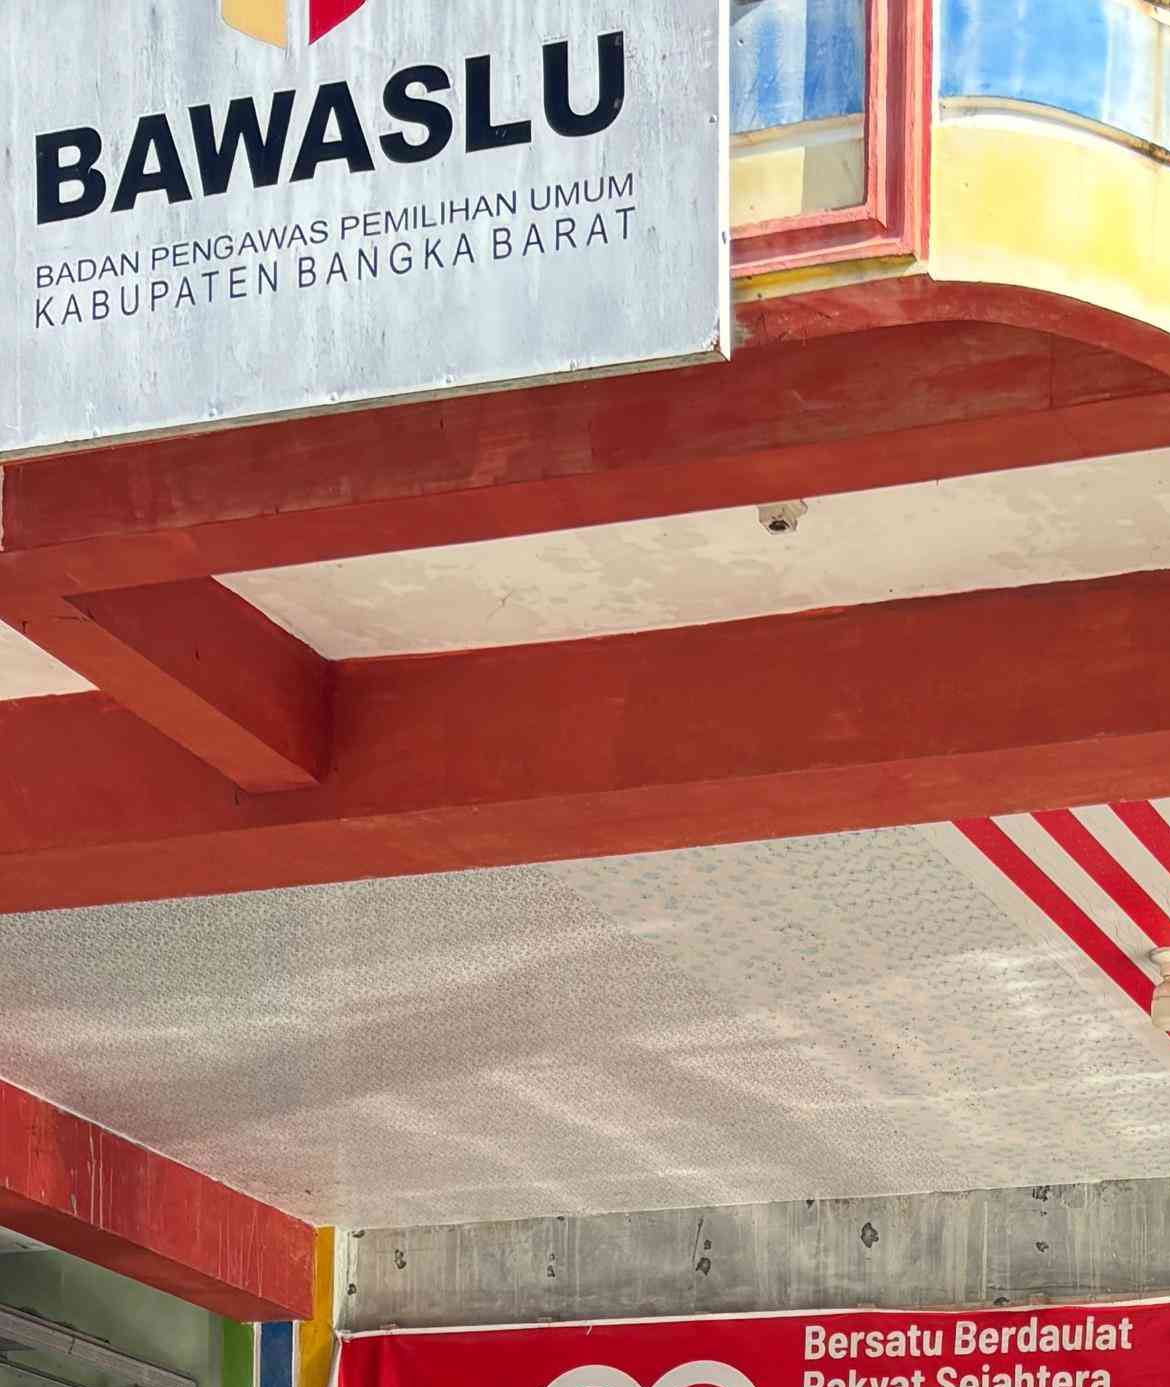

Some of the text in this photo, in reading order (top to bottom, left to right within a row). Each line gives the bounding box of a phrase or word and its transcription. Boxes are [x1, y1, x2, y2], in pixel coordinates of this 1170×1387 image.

[35, 31, 625, 225] BAWASLU
[36, 173, 635, 289] BADAN PENGAWAS PEMILIHAN UMUM
[36, 207, 637, 328] KABUPATEN BANGKA BARAT
[804, 1316, 1134, 1360] Bersatu Berdaulat
